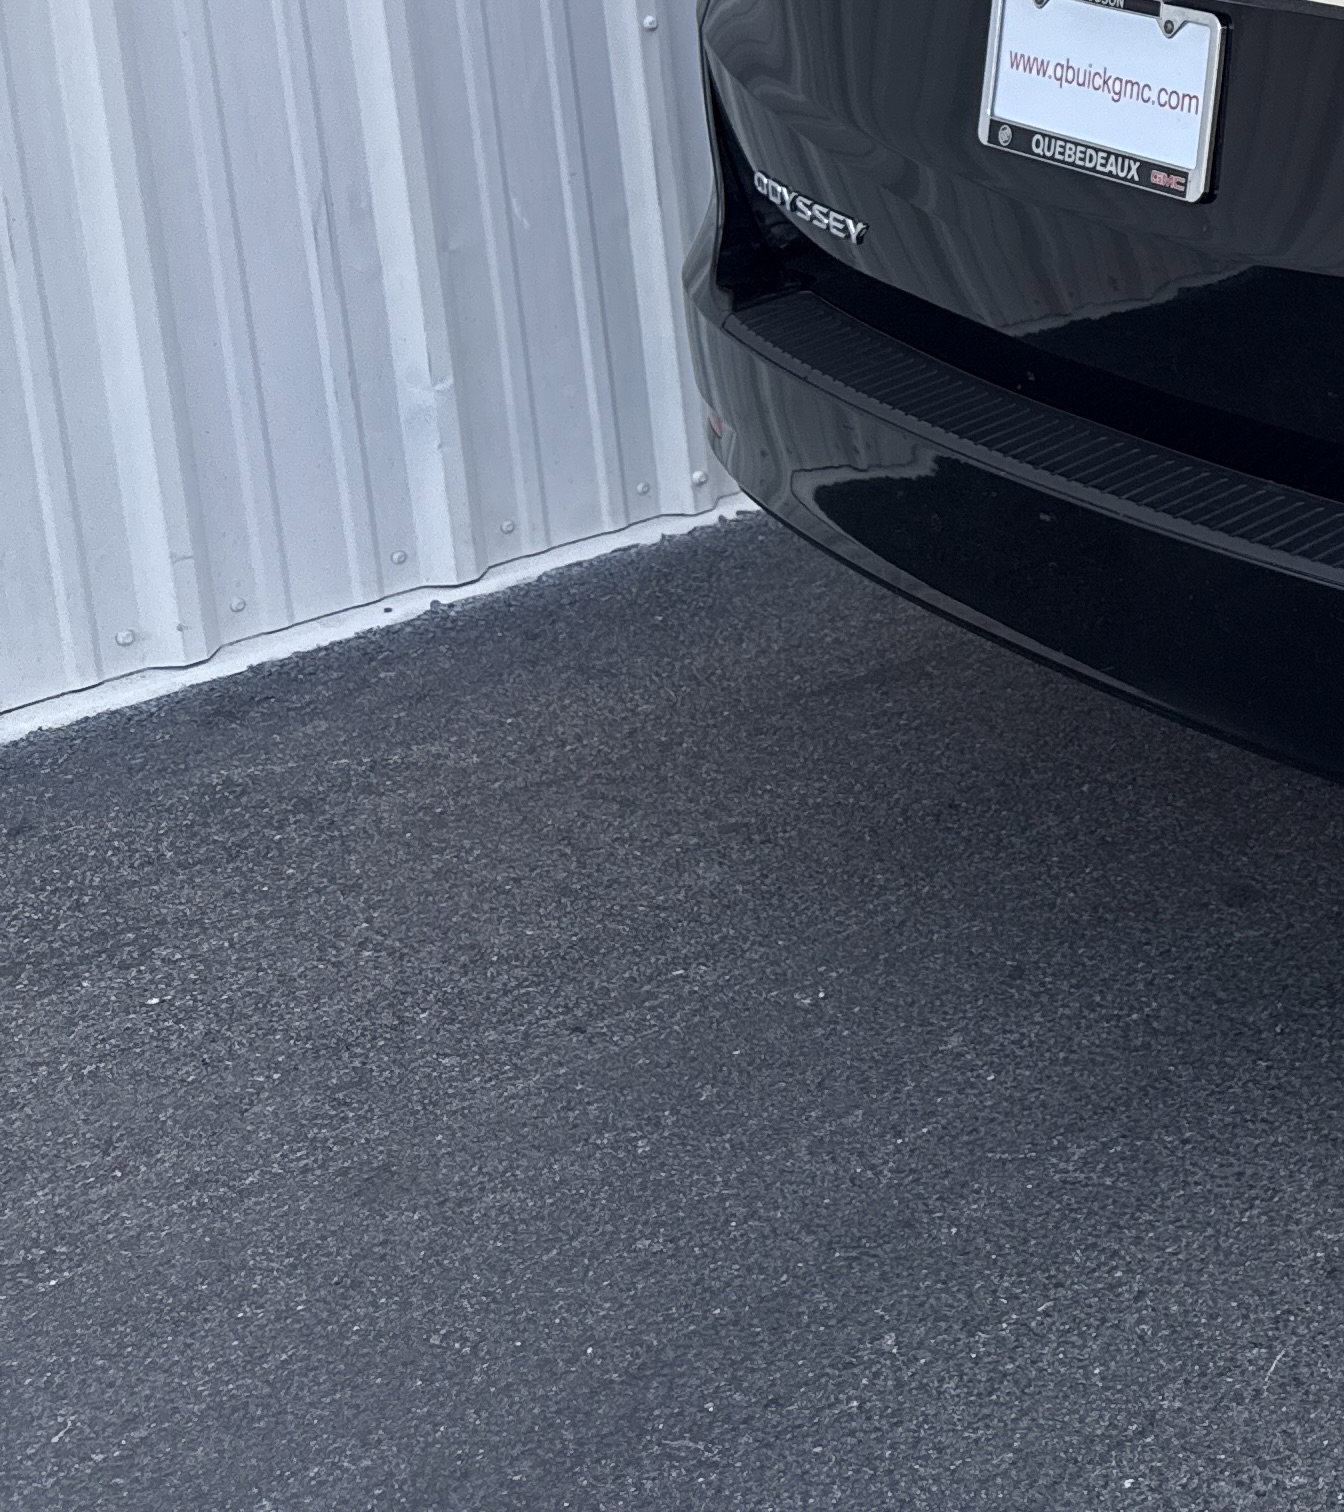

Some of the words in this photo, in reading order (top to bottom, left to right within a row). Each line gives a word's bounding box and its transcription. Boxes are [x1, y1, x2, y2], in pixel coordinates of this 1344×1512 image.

[1009, 50, 1200, 116] www.qbuickgmc.com
[1031, 133, 1141, 182] QUEBEDEAUX
[1151, 169, 1186, 192] GMC
[754, 170, 868, 246] ODYSSEY
